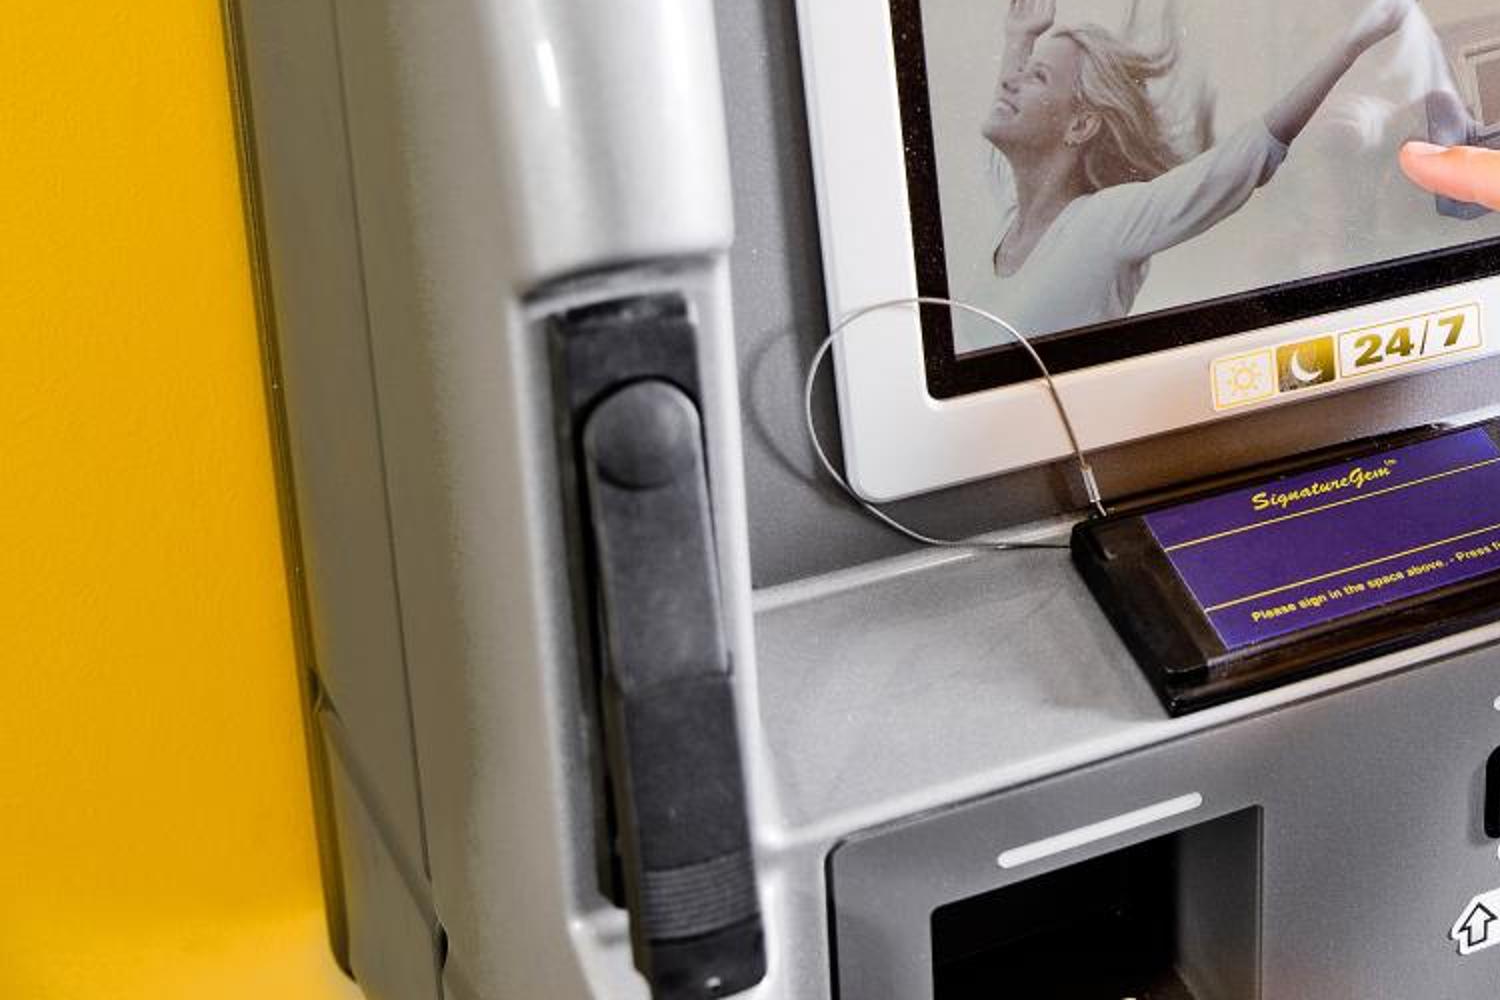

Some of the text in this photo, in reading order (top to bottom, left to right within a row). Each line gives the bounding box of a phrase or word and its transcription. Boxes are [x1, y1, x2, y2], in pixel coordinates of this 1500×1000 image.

[1353, 313, 1465, 368] 24/7
[1251, 602, 1297, 623] Please
[1298, 594, 1328, 609] sign
[1328, 588, 1343, 599] in
[1343, 583, 1366, 596] the
[1366, 571, 1405, 589] space
[1455, 545, 1492, 562] Press
